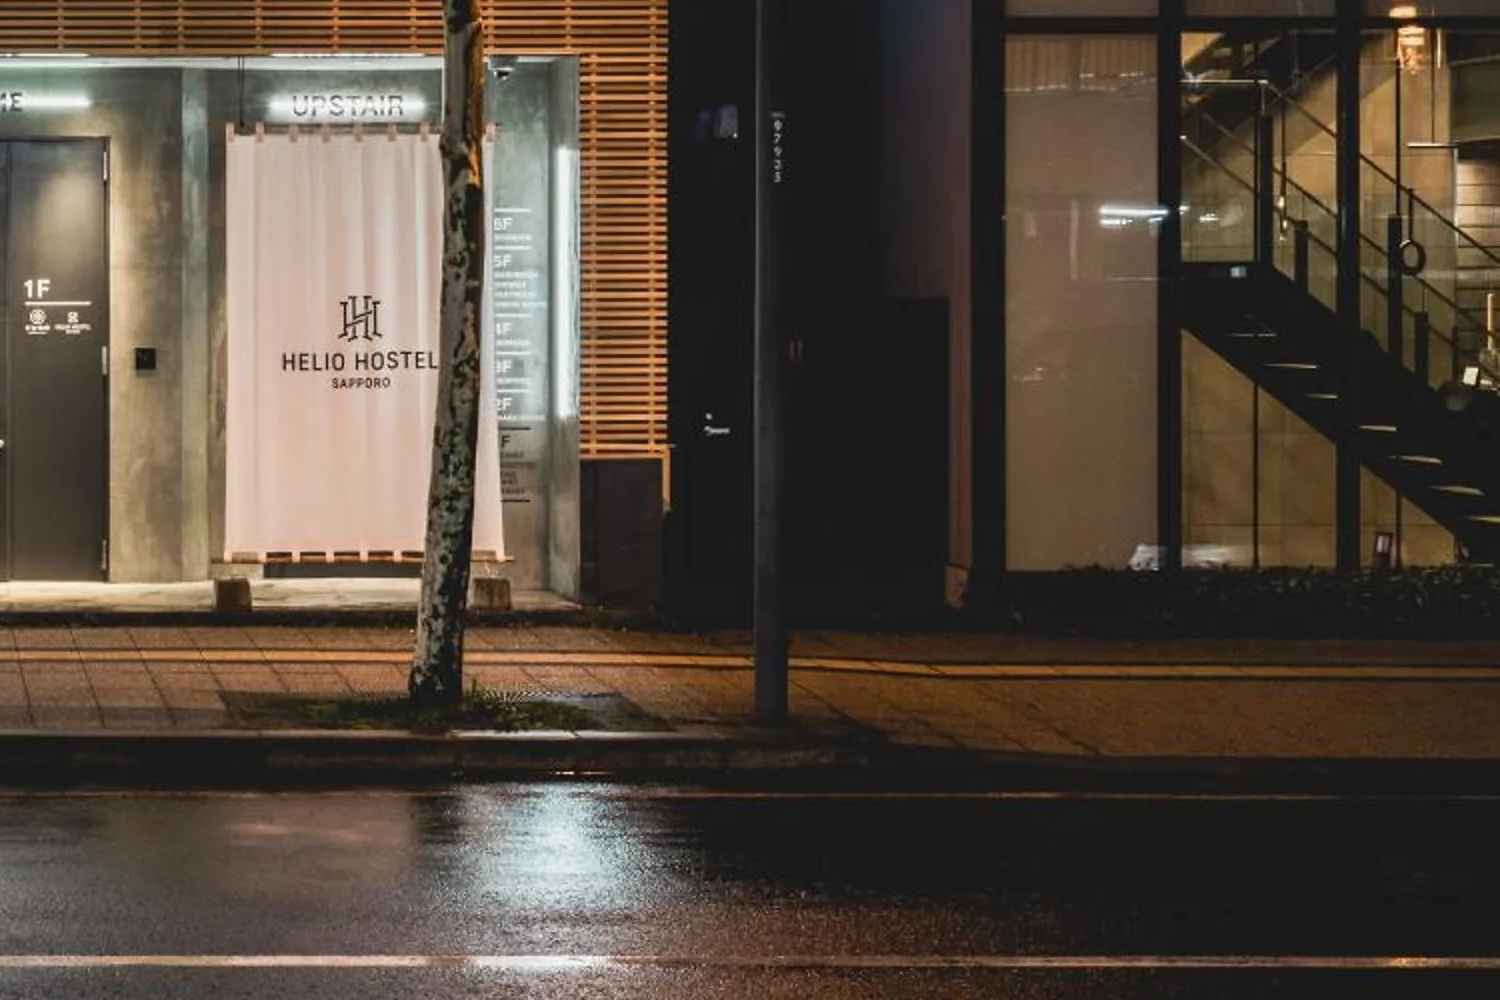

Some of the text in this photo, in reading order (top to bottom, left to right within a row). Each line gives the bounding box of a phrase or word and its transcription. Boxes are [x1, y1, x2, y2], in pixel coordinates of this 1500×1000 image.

[293, 95, 404, 116] UPSTAIR
[24, 279, 51, 298] 1F
[282, 351, 440, 371] HELIO HOSTEL
[332, 377, 391, 389] SAPPORO
